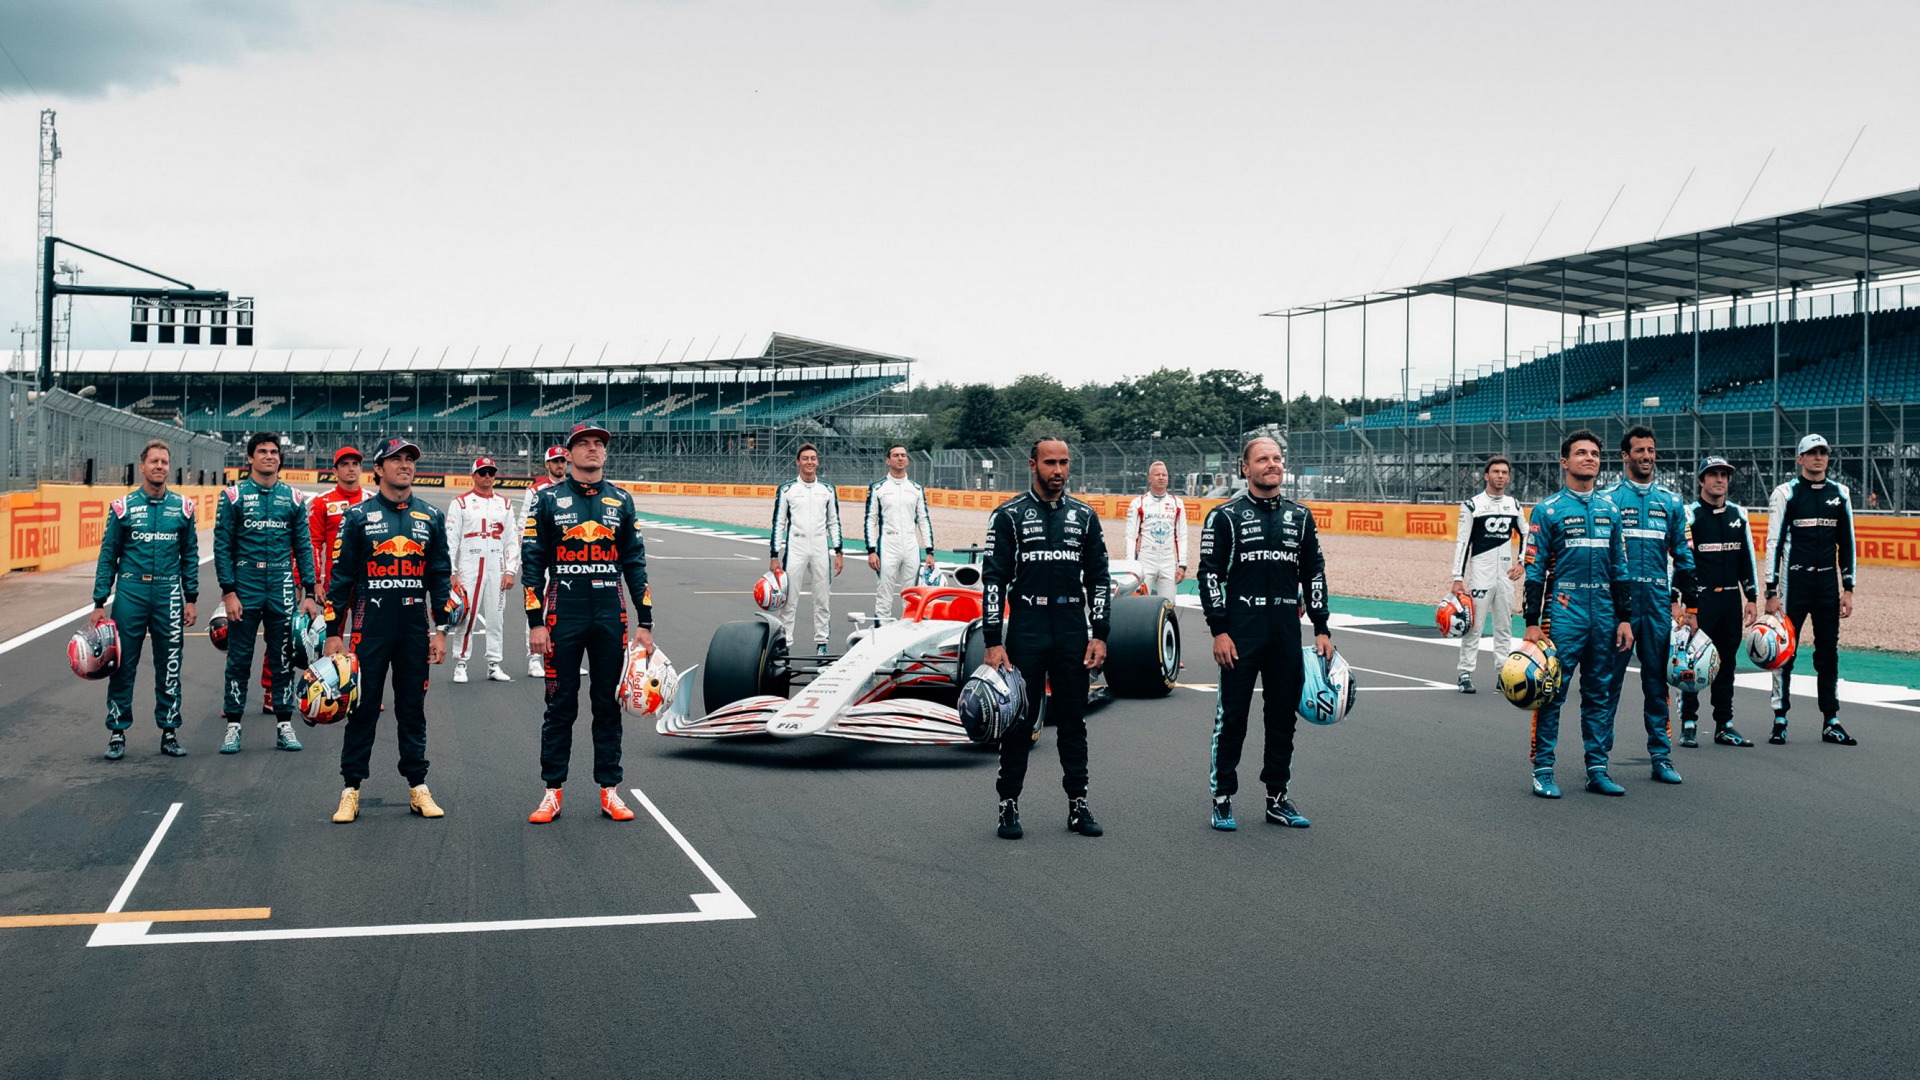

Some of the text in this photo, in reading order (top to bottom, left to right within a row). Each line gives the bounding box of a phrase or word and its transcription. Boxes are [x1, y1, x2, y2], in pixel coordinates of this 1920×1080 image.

[412, 477, 443, 485] ZERO
[454, 478, 474, 486] PIRE
[1184, 504, 1201, 520] ELLI
[1311, 508, 1333, 529] ELLI
[1347, 510, 1383, 532] PIRELLI
[10, 502, 61, 560] PIRELLI
[1064, 527, 1082, 535] INEOS
[1406, 512, 1447, 535] PIRELLI
[131, 530, 178, 542] Cognizant
[1854, 526, 1920, 561] IRELL
[557, 545, 618, 561] Red Bull
[1021, 550, 1080, 562] PETRONAS
[367, 559, 398, 577] Red
[556, 564, 617, 574] HONDA
[368, 580, 423, 589] HONDA
[1206, 572, 1221, 608] NEOS
[1311, 572, 1323, 609] NEOS
[987, 584, 1000, 624] INEOS
[165, 584, 181, 695] ASTON MARTIN
[633, 671, 645, 709] Red Bull
[776, 722, 799, 730] FIA
